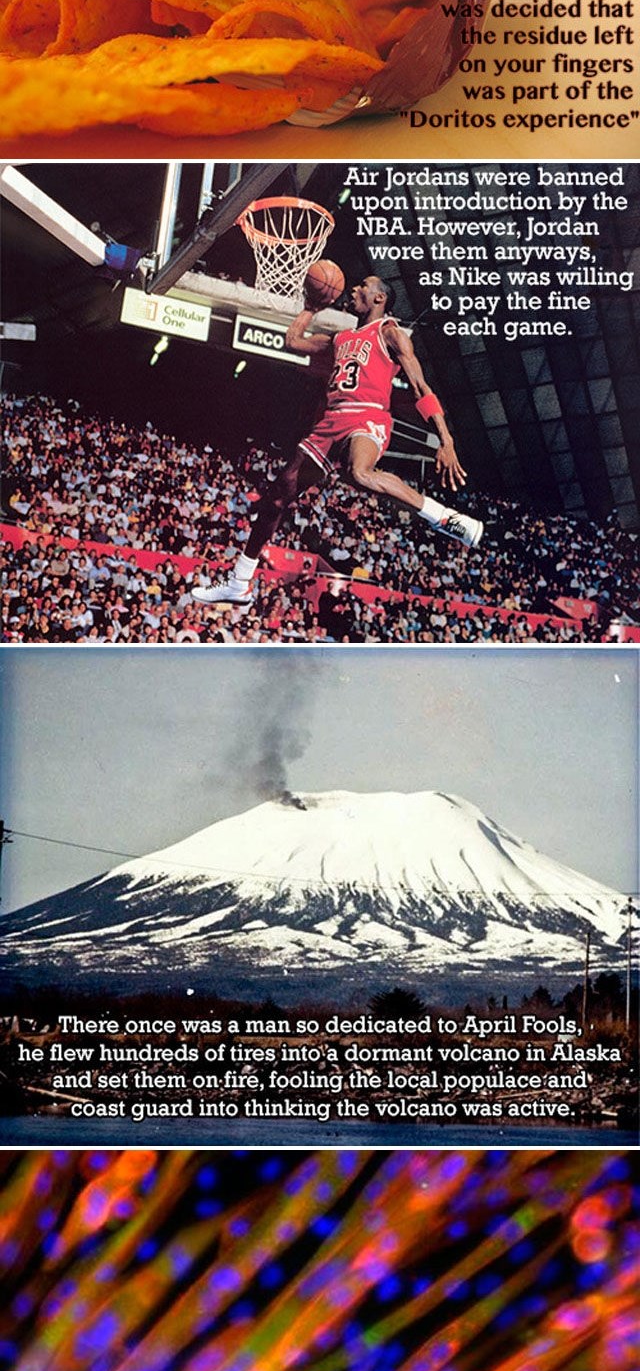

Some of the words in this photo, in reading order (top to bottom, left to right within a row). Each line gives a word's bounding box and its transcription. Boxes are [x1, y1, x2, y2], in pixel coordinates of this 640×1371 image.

[162, 316, 186, 328] One
[163, 305, 206, 323] Cellular
[243, 328, 285, 349] ARCO
